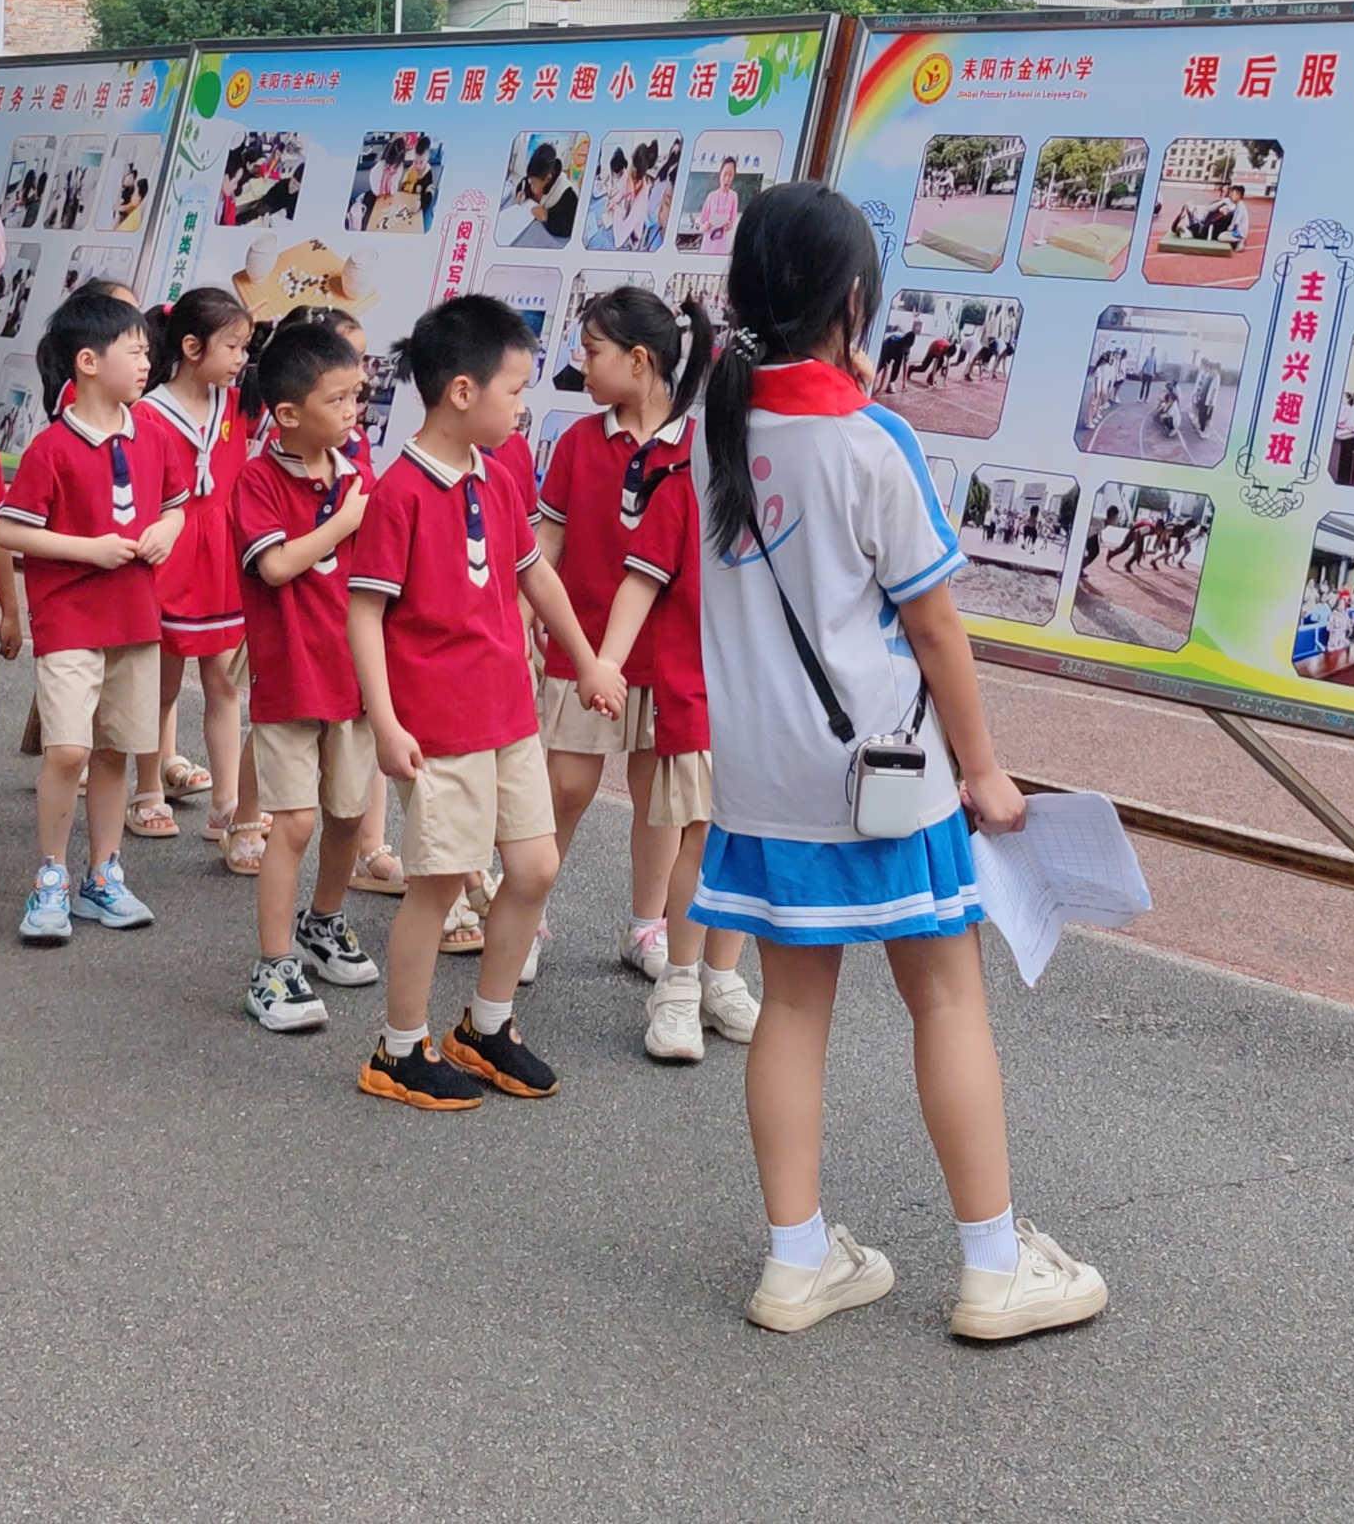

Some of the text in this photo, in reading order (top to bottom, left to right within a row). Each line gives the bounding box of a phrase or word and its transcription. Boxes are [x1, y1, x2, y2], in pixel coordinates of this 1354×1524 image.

[392, 61, 761, 102] 课后服务兴趣小组活动
[961, 55, 1094, 81] 耒阳市金杯小学
[980, 90, 1006, 99] Primary
[1008, 89, 1033, 98] School
[1265, 270, 1326, 465] 主持兴趣班
